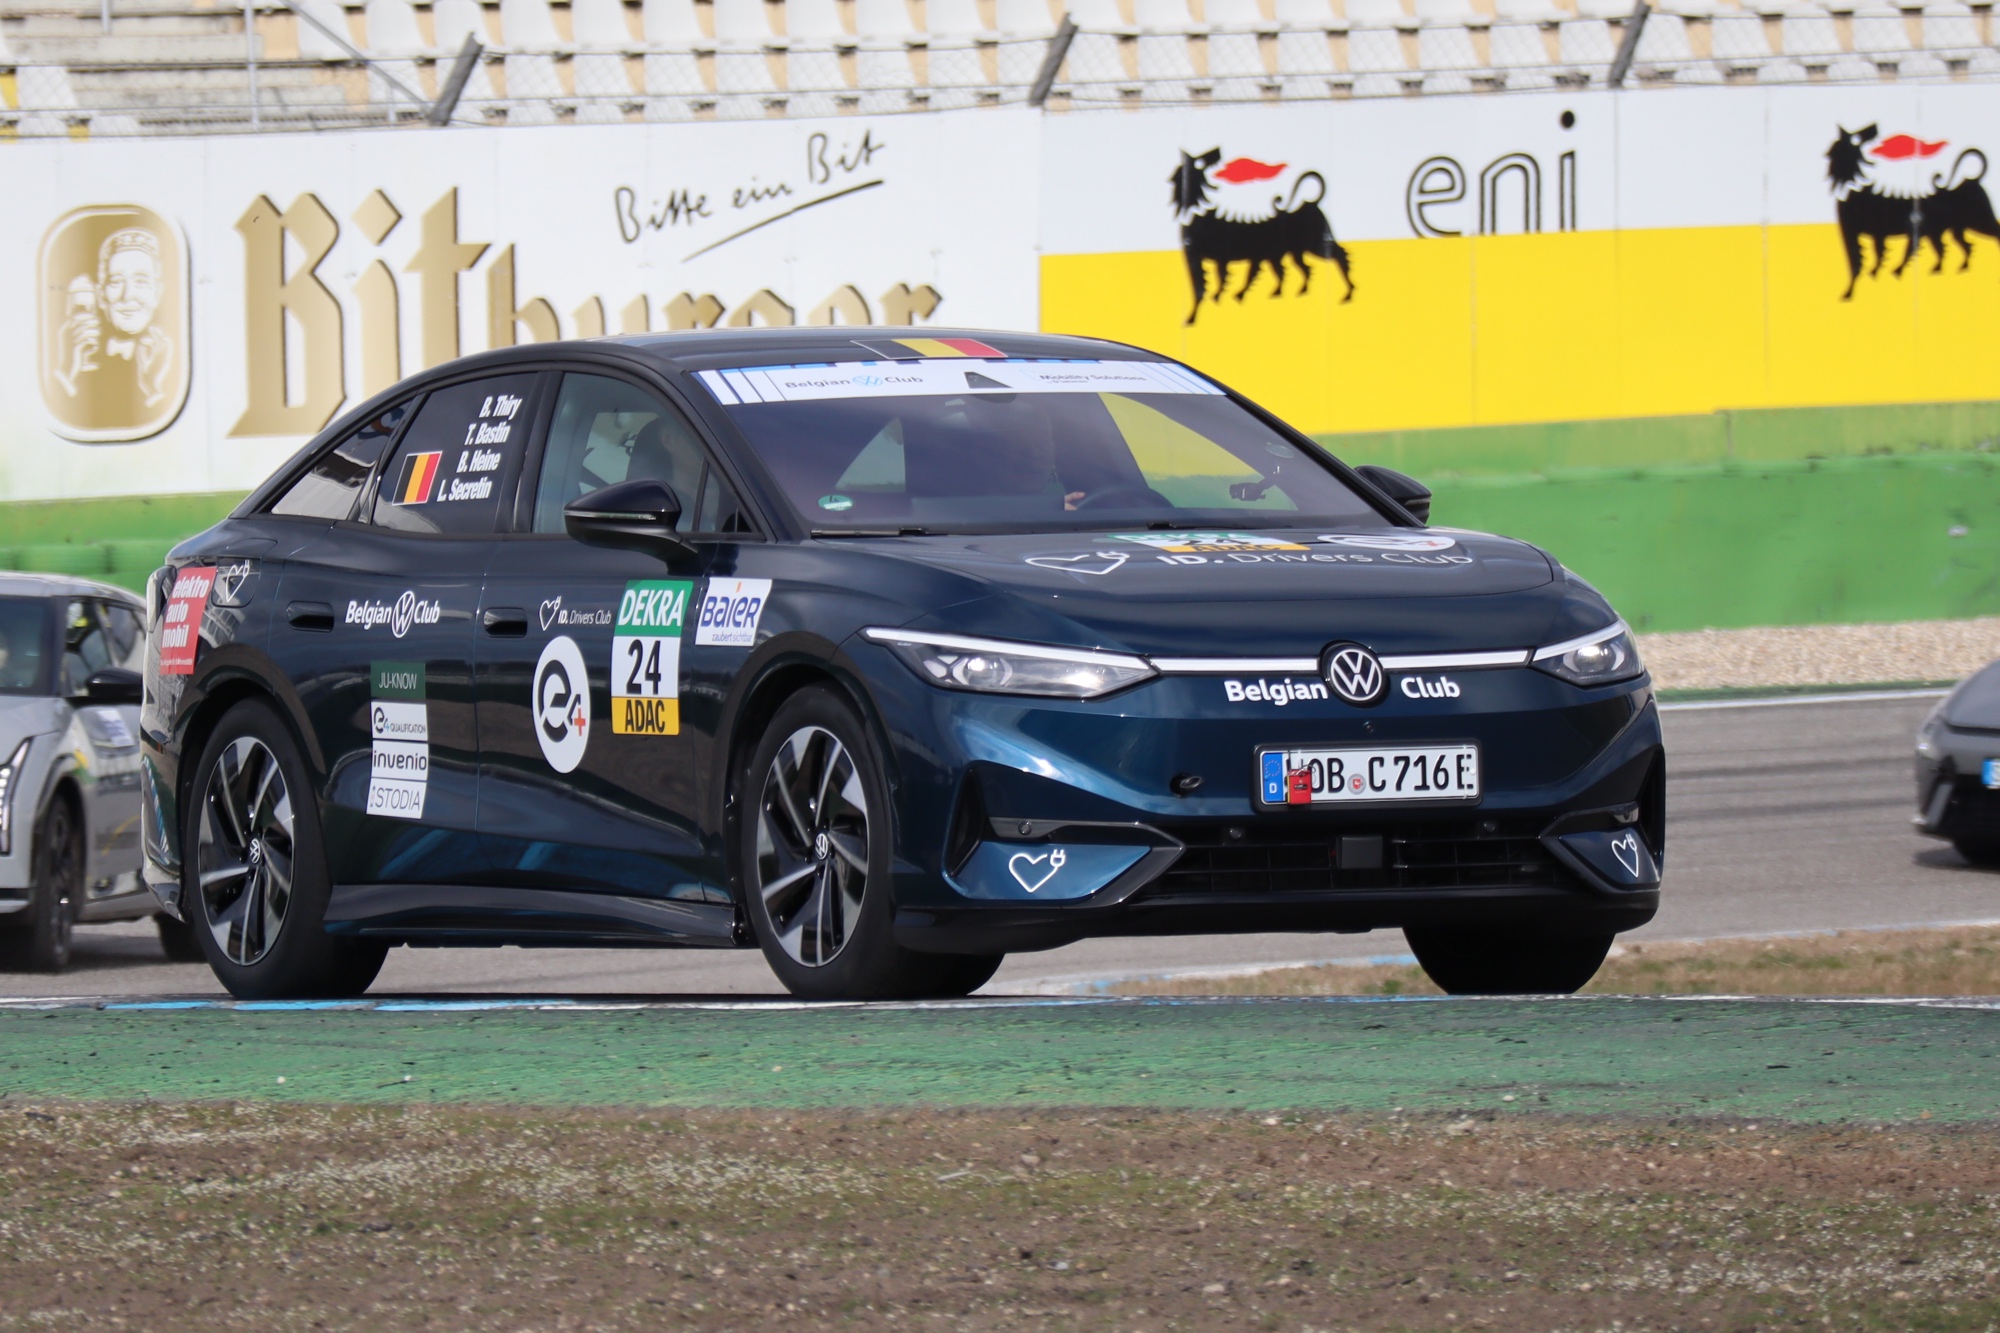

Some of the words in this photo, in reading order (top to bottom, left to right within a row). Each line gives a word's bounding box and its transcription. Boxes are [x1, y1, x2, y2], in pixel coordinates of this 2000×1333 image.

[614, 186, 713, 243] Bitte
[731, 176, 793, 209] ein
[807, 129, 885, 184] Bit
[1405, 109, 1577, 239] eni
[885, 375, 924, 384] Club
[479, 396, 493, 418] B.
[493, 394, 522, 420] Thiry
[464, 423, 477, 446] T.
[475, 421, 511, 445] Bastin
[469, 449, 501, 472] Heine
[436, 479, 447, 502] L.
[448, 476, 493, 501] Secretin
[1227, 552, 1373, 563] Drivers
[1381, 553, 1473, 564] Club
[171, 576, 209, 599] elektro
[165, 600, 189, 623] auto
[345, 600, 392, 630] Belgian
[414, 600, 440, 624] Club
[569, 609, 595, 624] Drivers
[595, 609, 612, 625] Club
[617, 589, 686, 627] DEKRA
[162, 624, 190, 648] mobil
[626, 639, 662, 695] 24
[378, 672, 417, 690] JU-KNOW
[1224, 678, 1329, 706] Belgian
[1401, 676, 1461, 698] Club
[625, 699, 665, 733] ADAC
[390, 723, 427, 734] QUALIFICATION
[373, 750, 427, 771] invenio
